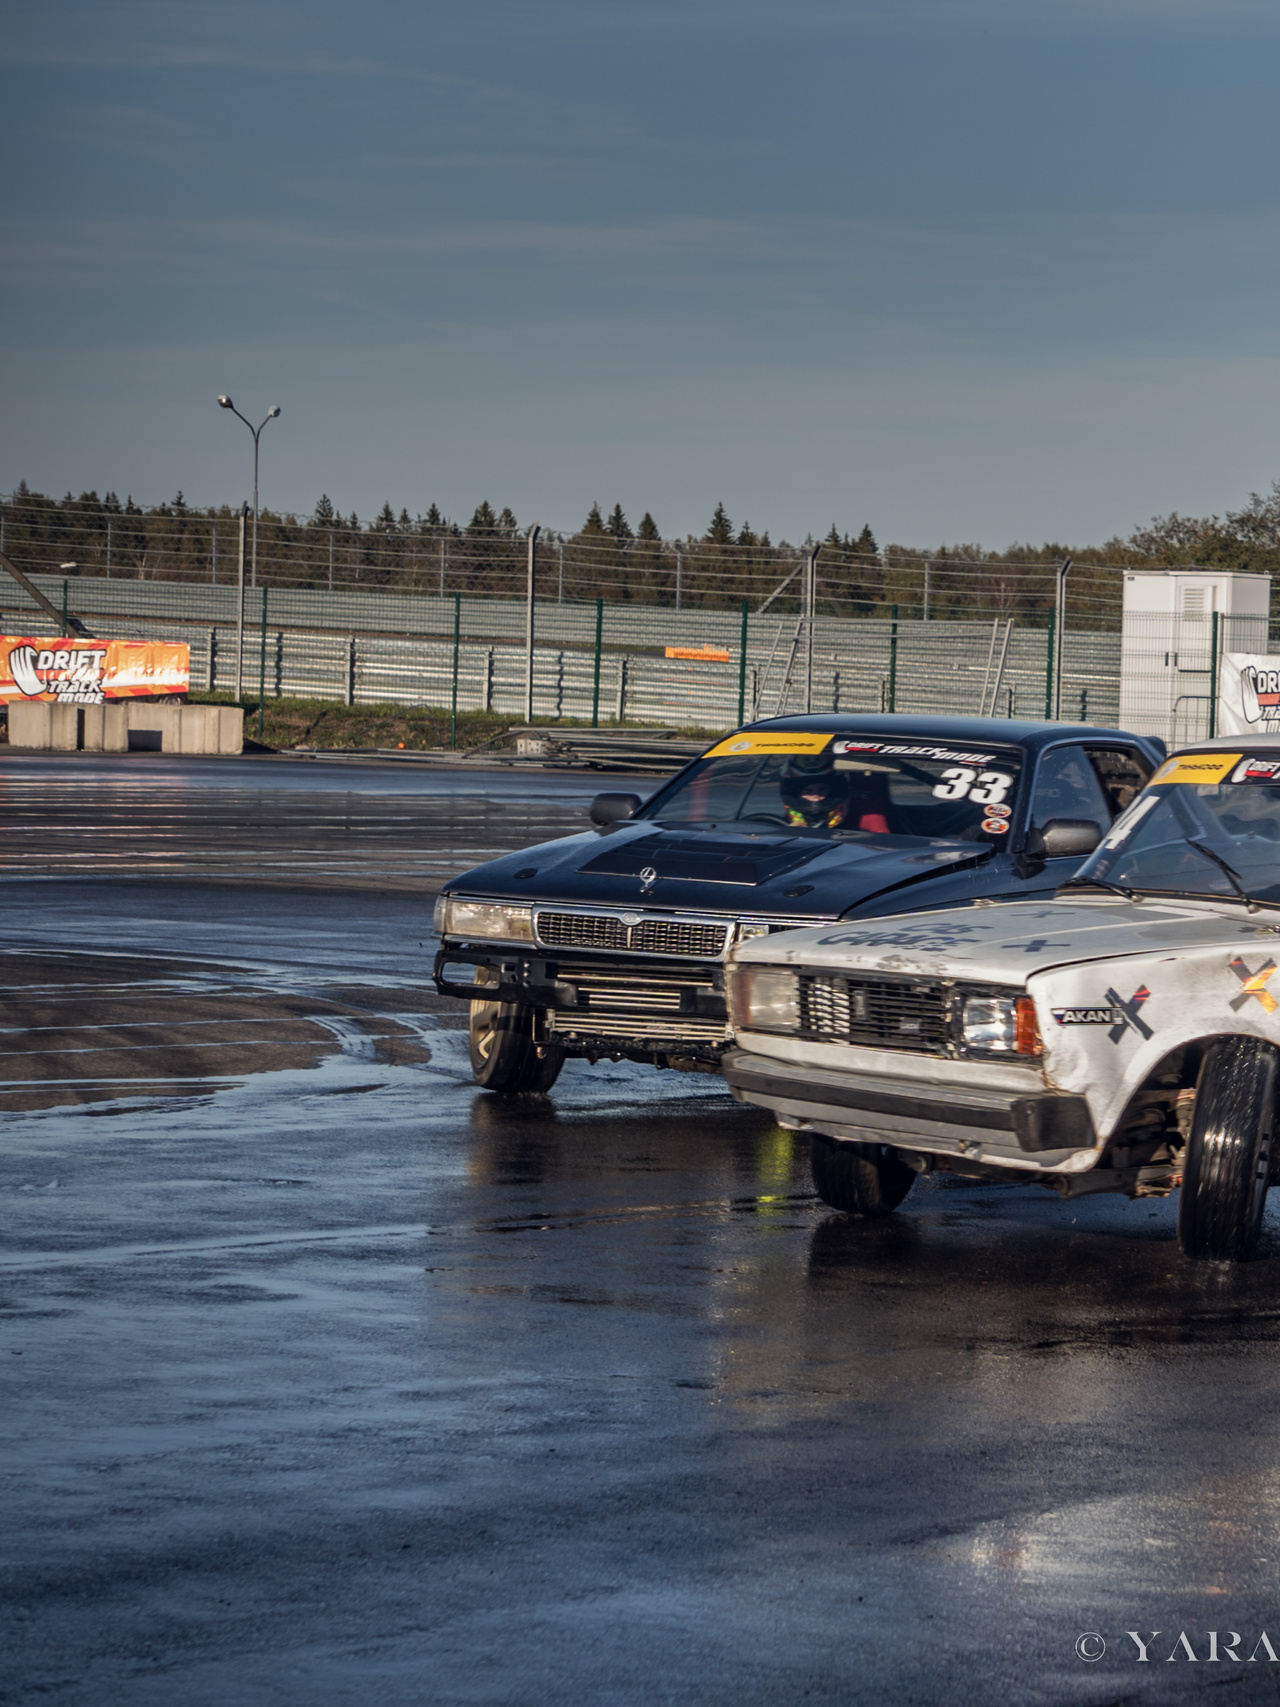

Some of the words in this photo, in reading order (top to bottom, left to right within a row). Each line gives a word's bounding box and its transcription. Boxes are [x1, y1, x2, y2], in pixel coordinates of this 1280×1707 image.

[37, 650, 106, 670] DRIFT
[49, 679, 102, 693] TRACK
[56, 692, 105, 704] MODE
[847, 742, 885, 750] DRIFT
[879, 745, 949, 756] TRACK
[932, 751, 997, 763] MODE
[932, 767, 1014, 804] 33
